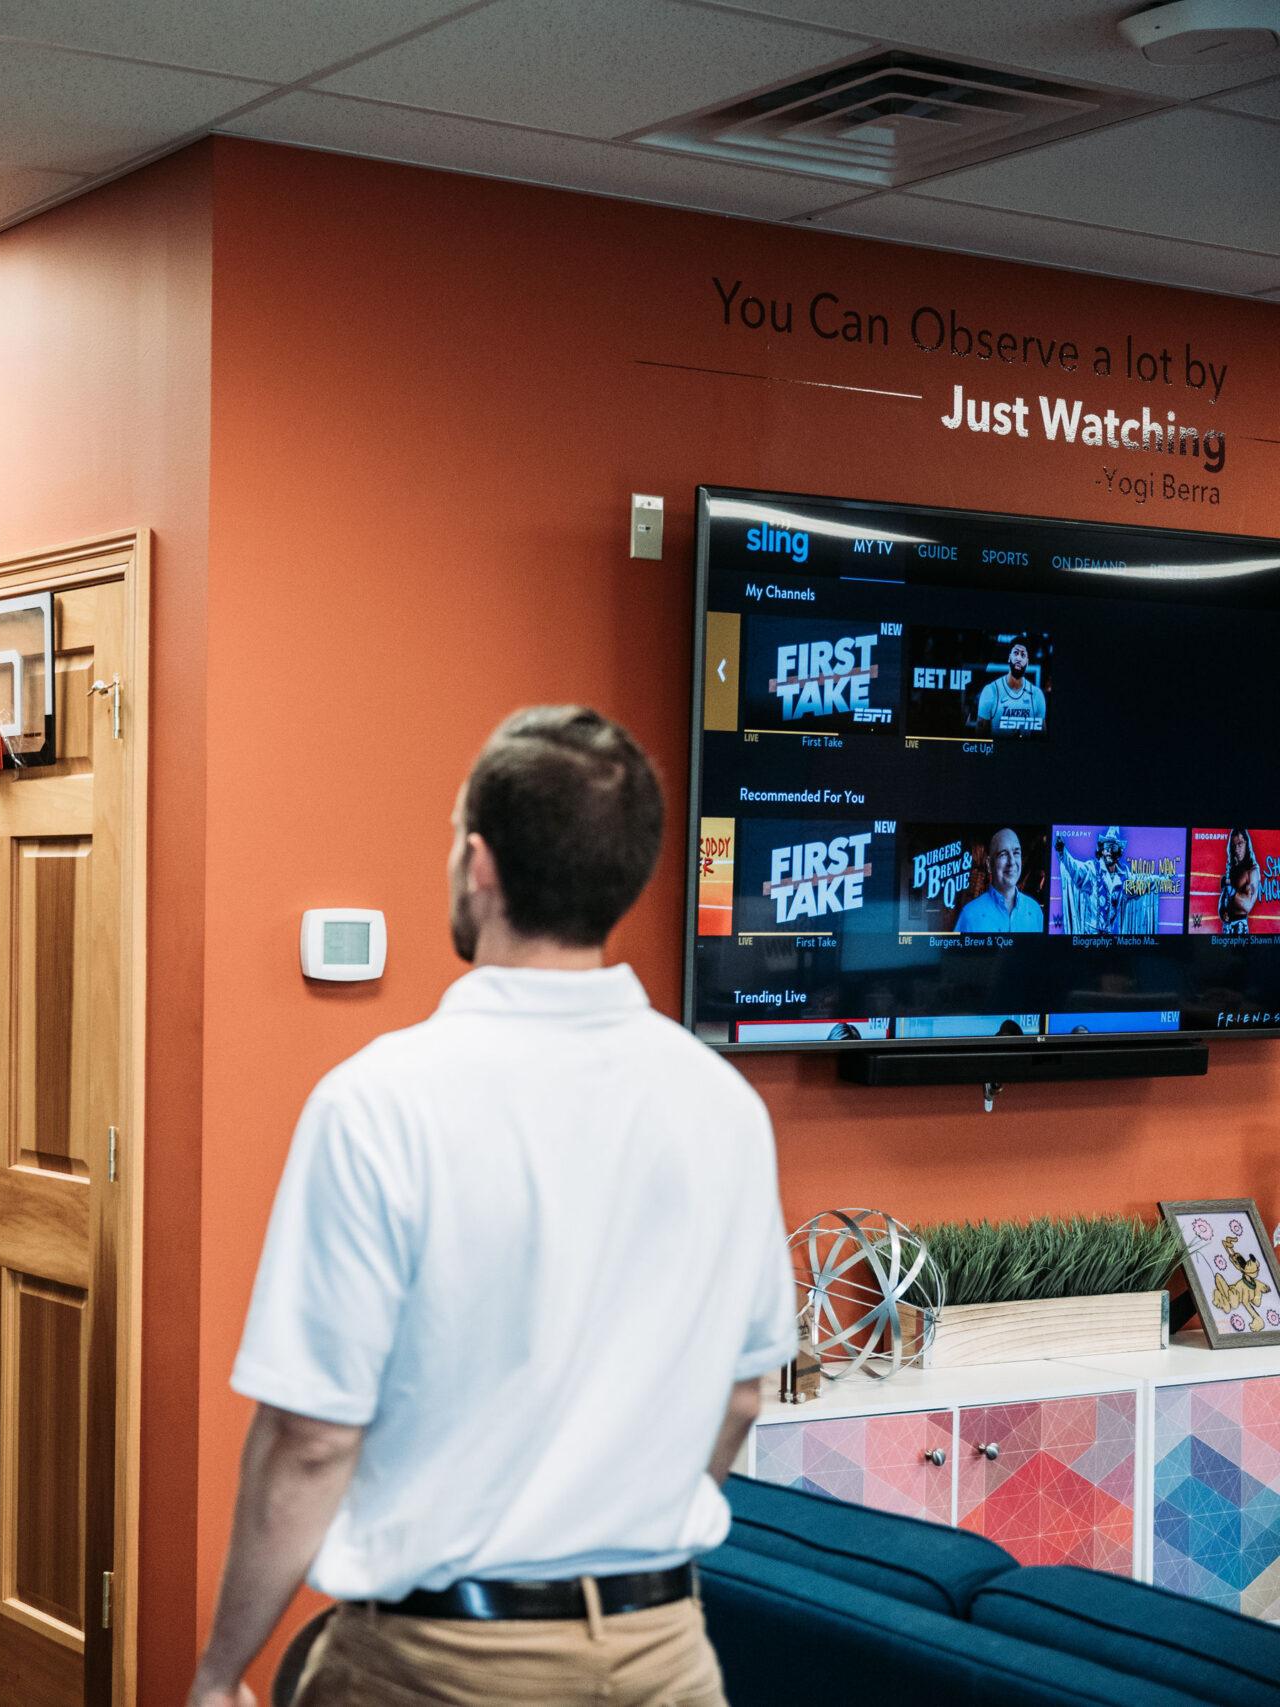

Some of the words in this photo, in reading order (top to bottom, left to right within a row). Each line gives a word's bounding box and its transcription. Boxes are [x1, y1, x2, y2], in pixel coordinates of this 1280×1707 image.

[712, 277, 792, 333] You
[809, 292, 888, 346] Can
[910, 306, 1079, 372] Observe
[1093, 346, 1111, 377] a
[1127, 335, 1173, 386] lot
[1185, 343, 1228, 404] by
[941, 384, 1029, 438] Just
[1038, 395, 1226, 473] Watching
[1094, 466, 1154, 504] -Yogi
[1163, 473, 1221, 505] Berra
[746, 521, 809, 563] sling
[853, 538, 873, 554] MY
[876, 540, 894, 555] TV
[917, 544, 958, 560] GUIDE
[982, 550, 1029, 566] SPORTS
[1052, 555, 1071, 569] ON
[1075, 557, 1127, 573] DEMAND
[745, 583, 763, 601] My
[766, 585, 816, 601] Channels
[880, 622, 903, 636] NEW
[777, 634, 878, 684] FIRST
[913, 667, 946, 690] GET
[949, 669, 972, 691] UP
[776, 673, 870, 722] TAKE
[853, 707, 892, 723] ESPN
[999, 715, 1042, 730] ESPN2
[744, 733, 759, 742] LIVE
[802, 735, 822, 747] First
[824, 736, 843, 748] Take
[905, 739, 919, 748] LIVE
[963, 743, 978, 753] Get
[979, 743, 993, 755] Up!
[740, 788, 820, 803] Recommended
[823, 790, 842, 803] For
[844, 791, 865, 804] You
[874, 820, 896, 834] NEW
[1055, 830, 1092, 838] BIOGRAPHY
[1195, 833, 1228, 841] BIOGRAPHY
[771, 832, 872, 886] FIRST
[962, 851, 973, 870] &
[770, 871, 864, 924] TAKE
[738, 936, 753, 945] LIVE
[796, 937, 815, 948] First
[818, 937, 836, 948] Take
[899, 936, 913, 945] LIVE
[929, 936, 962, 949] Burgers,
[965, 936, 985, 946] Brew
[987, 936, 993, 946] &
[1073, 936, 1112, 948] Biography:
[1211, 936, 1248, 948] Biography:
[1250, 936, 1271, 945] Shawn
[734, 990, 782, 1007] Trending
[785, 990, 807, 1004] Live
[869, 1017, 890, 1030] NEW
[1020, 1014, 1040, 1027] NEW
[1160, 1011, 1180, 1023] NEW
